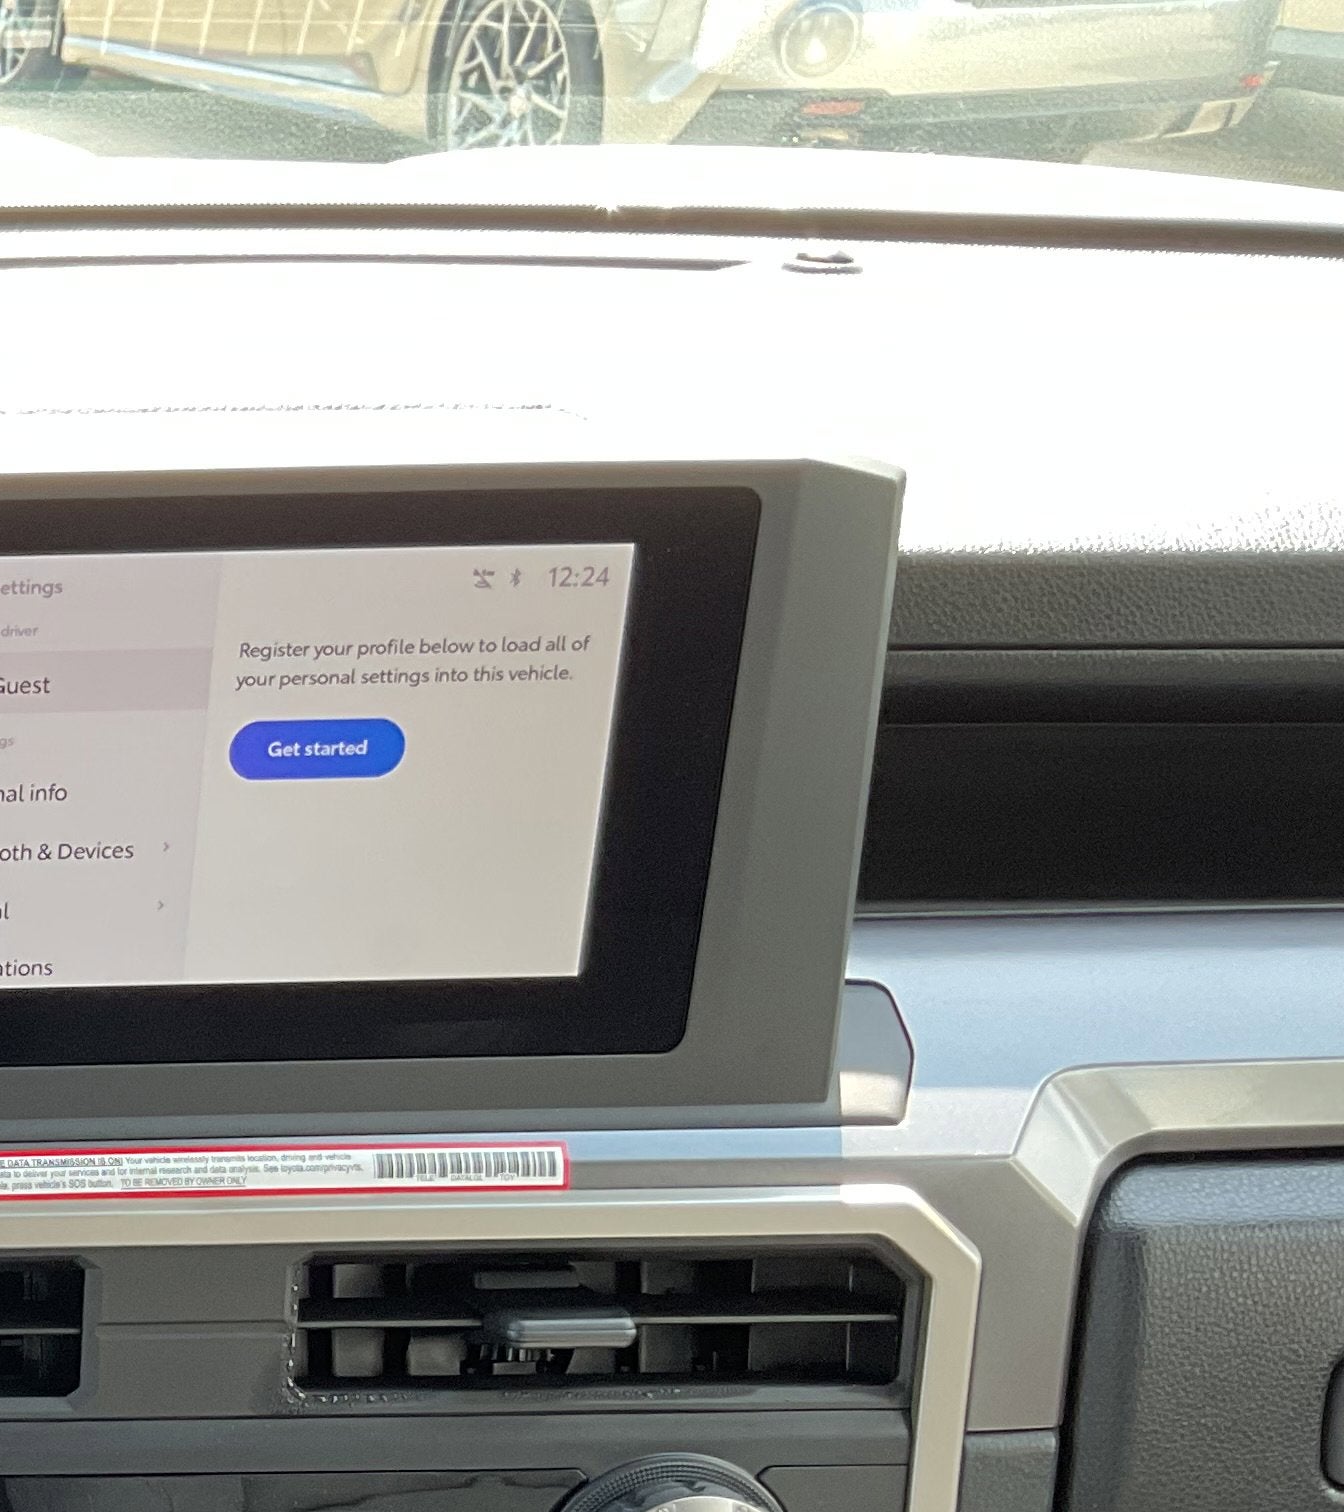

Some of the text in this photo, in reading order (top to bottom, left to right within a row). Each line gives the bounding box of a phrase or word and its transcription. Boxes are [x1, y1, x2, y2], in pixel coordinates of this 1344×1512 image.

[548, 567, 610, 588] 12:24
[0, 625, 38, 638] driver
[239, 634, 592, 661] Register your profile below to load all of
[235, 663, 573, 692] your personal settings into this vehicle.
[267, 739, 368, 757] Get started
[30, 783, 68, 802] info
[37, 844, 52, 861] &
[57, 841, 135, 860] Devices
[7, 1158, 30, 1167] DATA
[32, 1157, 96, 1167] TRANSMISSION
[98, 1157, 106, 1166] IS
[125, 1156, 142, 1165] Your
[145, 1156, 171, 1164] vehicle
[173, 1155, 209, 1165] wirelessly
[211, 1155, 245, 1163] transmits
[281, 1153, 306, 1163] driving
[308, 1153, 323, 1162] and
[325, 1152, 352, 1161] vehicle
[13, 1169, 21, 1178] to
[22, 1168, 48, 1178] deliver
[50, 1169, 67, 1179] your
[68, 1168, 99, 1177] services
[101, 1167, 116, 1176] and
[117, 1166, 128, 1176] for
[159, 1165, 192, 1174] research
[194, 1165, 208, 1174] and
[209, 1164, 227, 1173] data
[263, 1163, 279, 1173] See
[12, 1180, 33, 1190] press
[68, 1179, 86, 1189] SOS
[120, 1178, 131, 1187] TO
[132, 1178, 143, 1187] BE
[144, 1177, 183, 1187] REMOVED
[185, 1176, 195, 1185] BY
[196, 1176, 226, 1185] OWNER
[226, 1175, 248, 1185] ONLY
